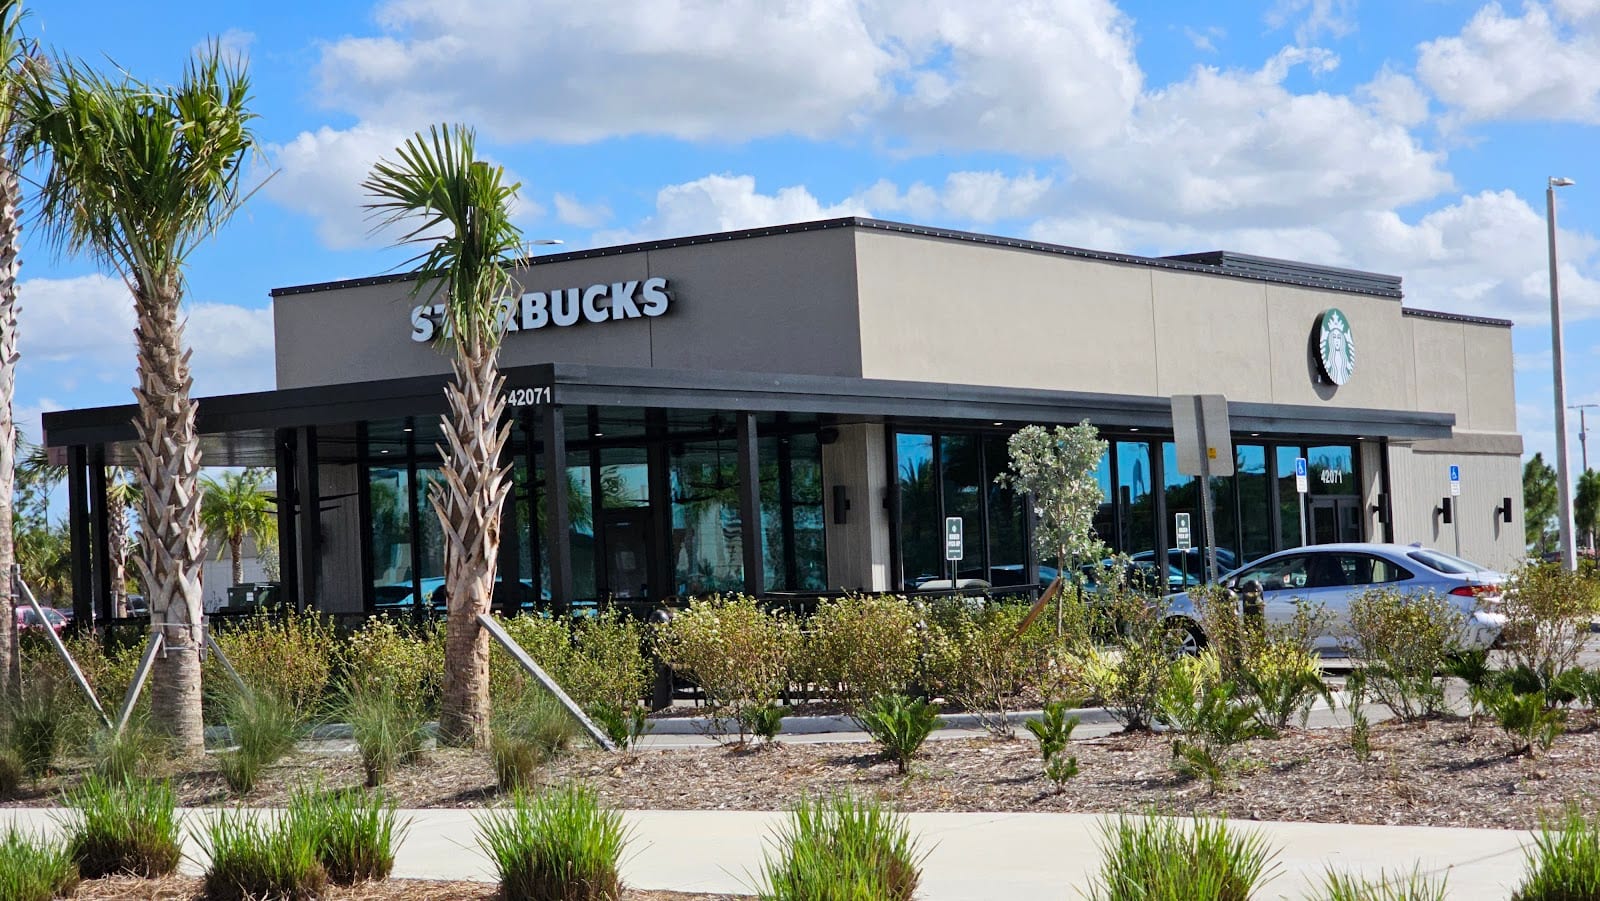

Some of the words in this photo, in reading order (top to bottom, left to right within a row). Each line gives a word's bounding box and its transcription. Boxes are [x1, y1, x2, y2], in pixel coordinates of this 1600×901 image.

[411, 277, 669, 342] STRBUCKS
[508, 386, 551, 406] 42071
[1320, 469, 1343, 484] 42071
